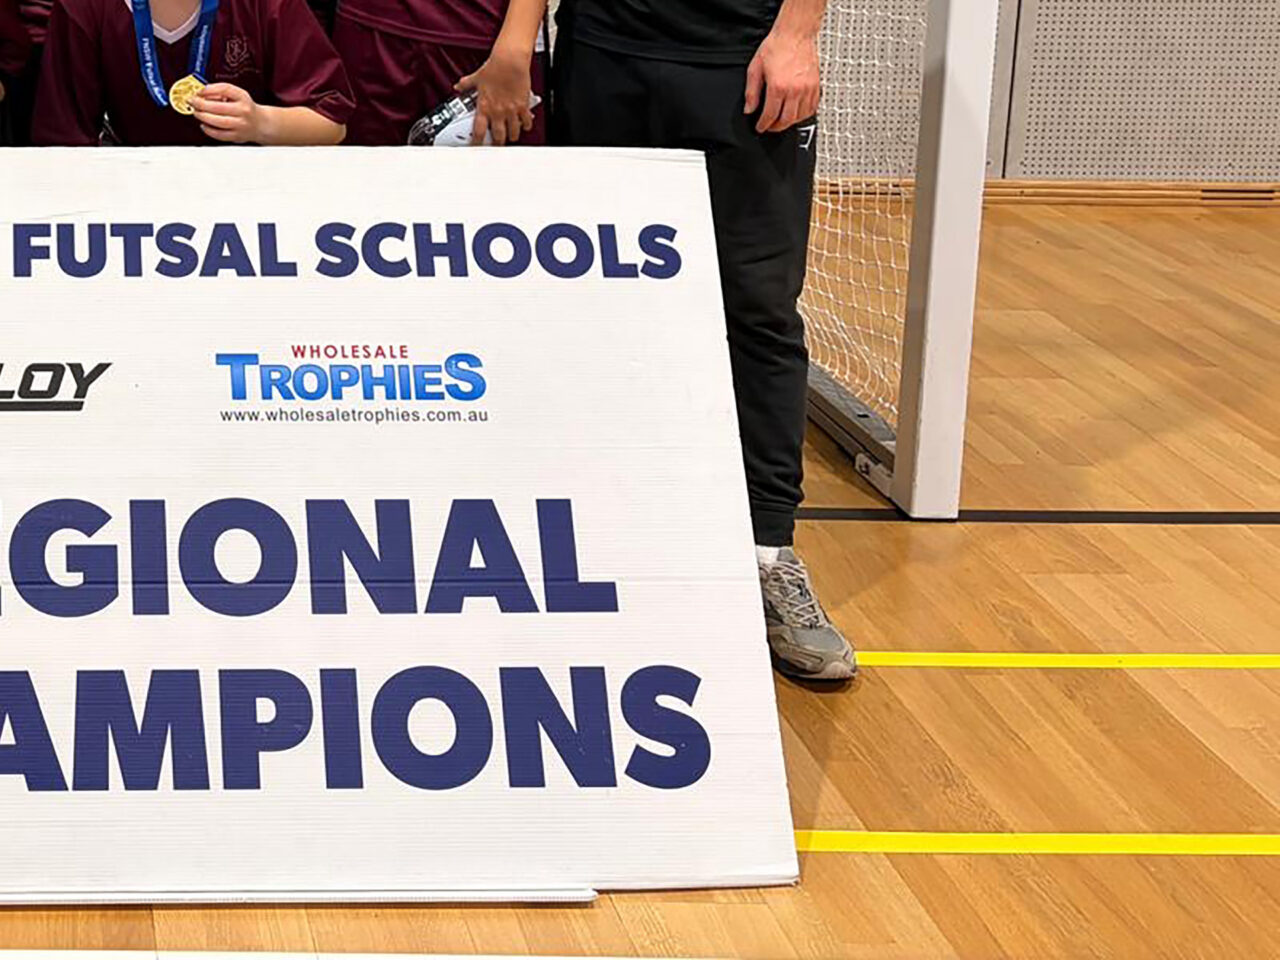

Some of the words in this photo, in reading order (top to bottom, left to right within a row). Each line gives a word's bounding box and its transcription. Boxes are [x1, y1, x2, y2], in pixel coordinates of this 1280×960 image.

[12, 222, 298, 279] FUTSAL
[314, 222, 683, 280] SCHOOLS
[291, 344, 409, 359] WHOLESALE
[219, 406, 489, 425] www.wholesaletrophies.com.au
